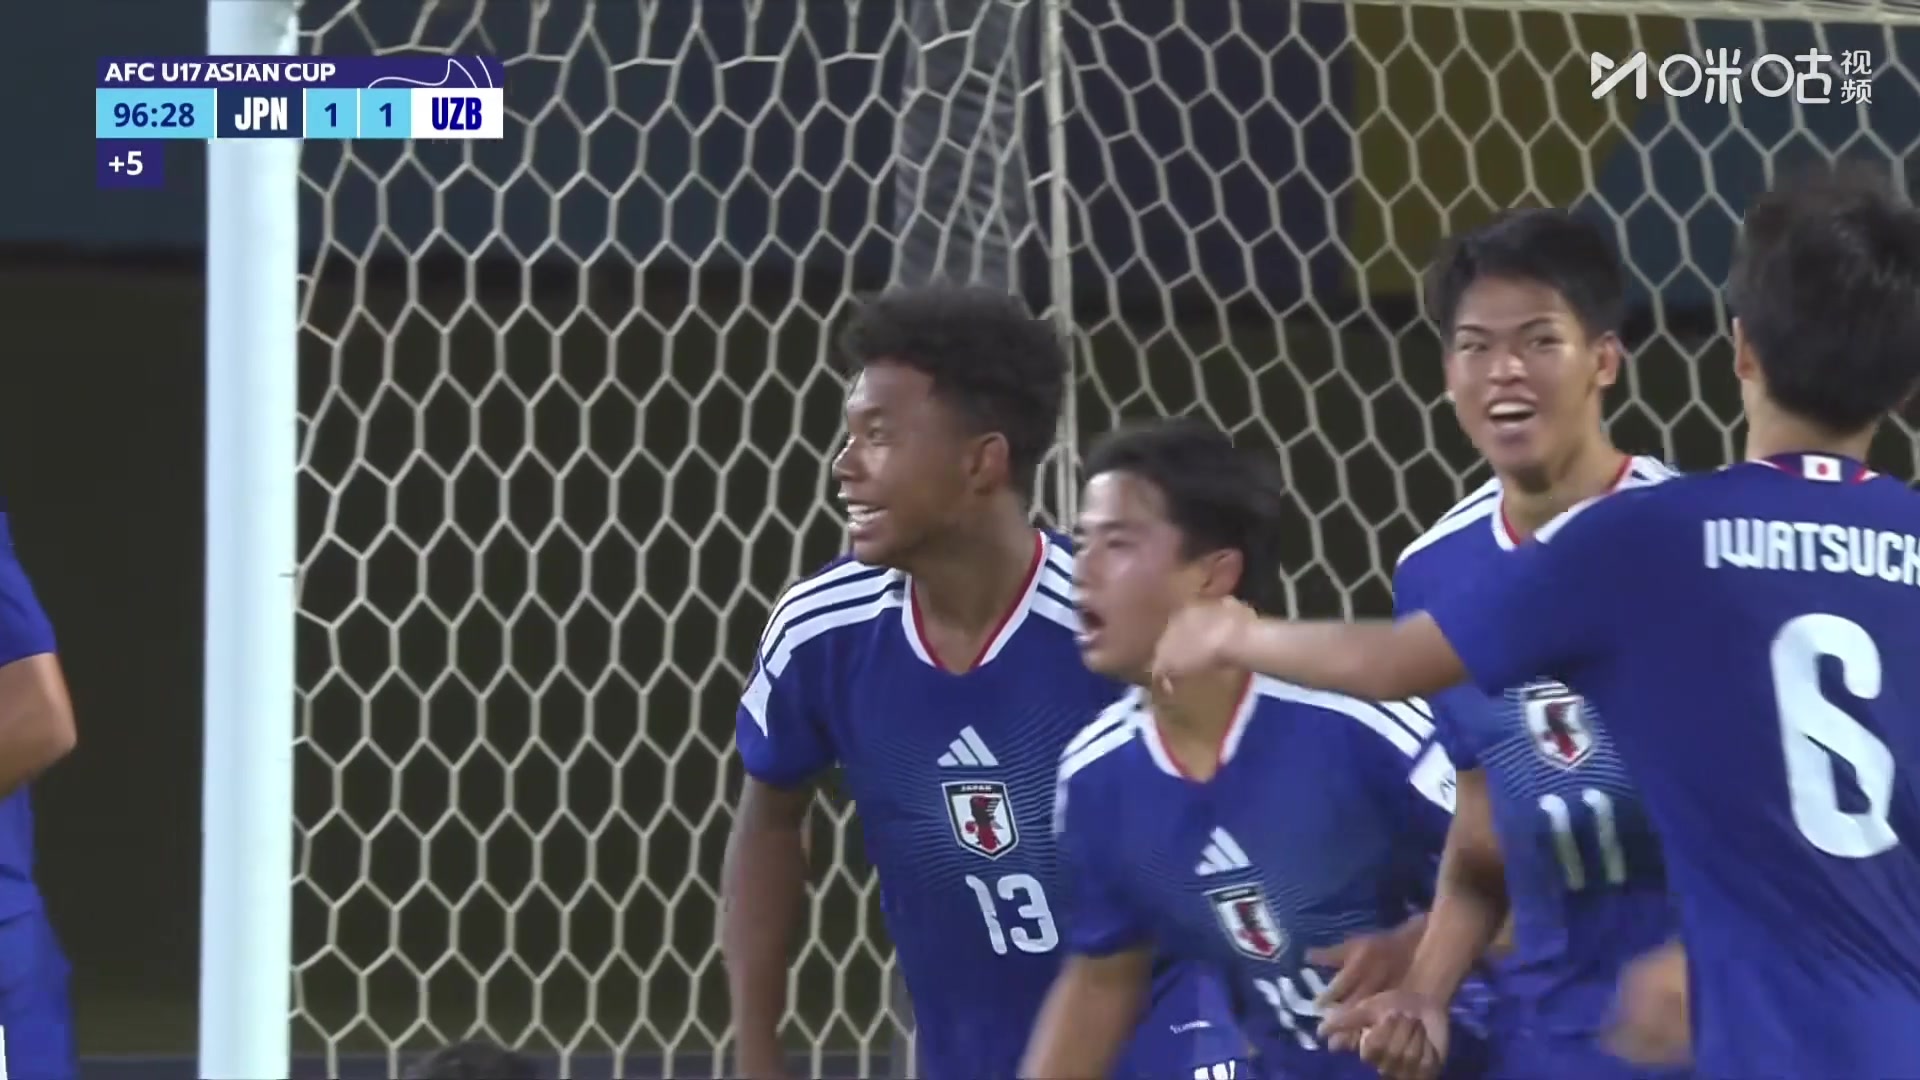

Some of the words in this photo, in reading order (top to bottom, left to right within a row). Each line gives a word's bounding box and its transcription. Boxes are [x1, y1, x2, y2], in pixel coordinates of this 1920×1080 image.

[1768, 612, 1900, 859] 6
[1537, 788, 1627, 891] 11
[965, 873, 1059, 956] 13
